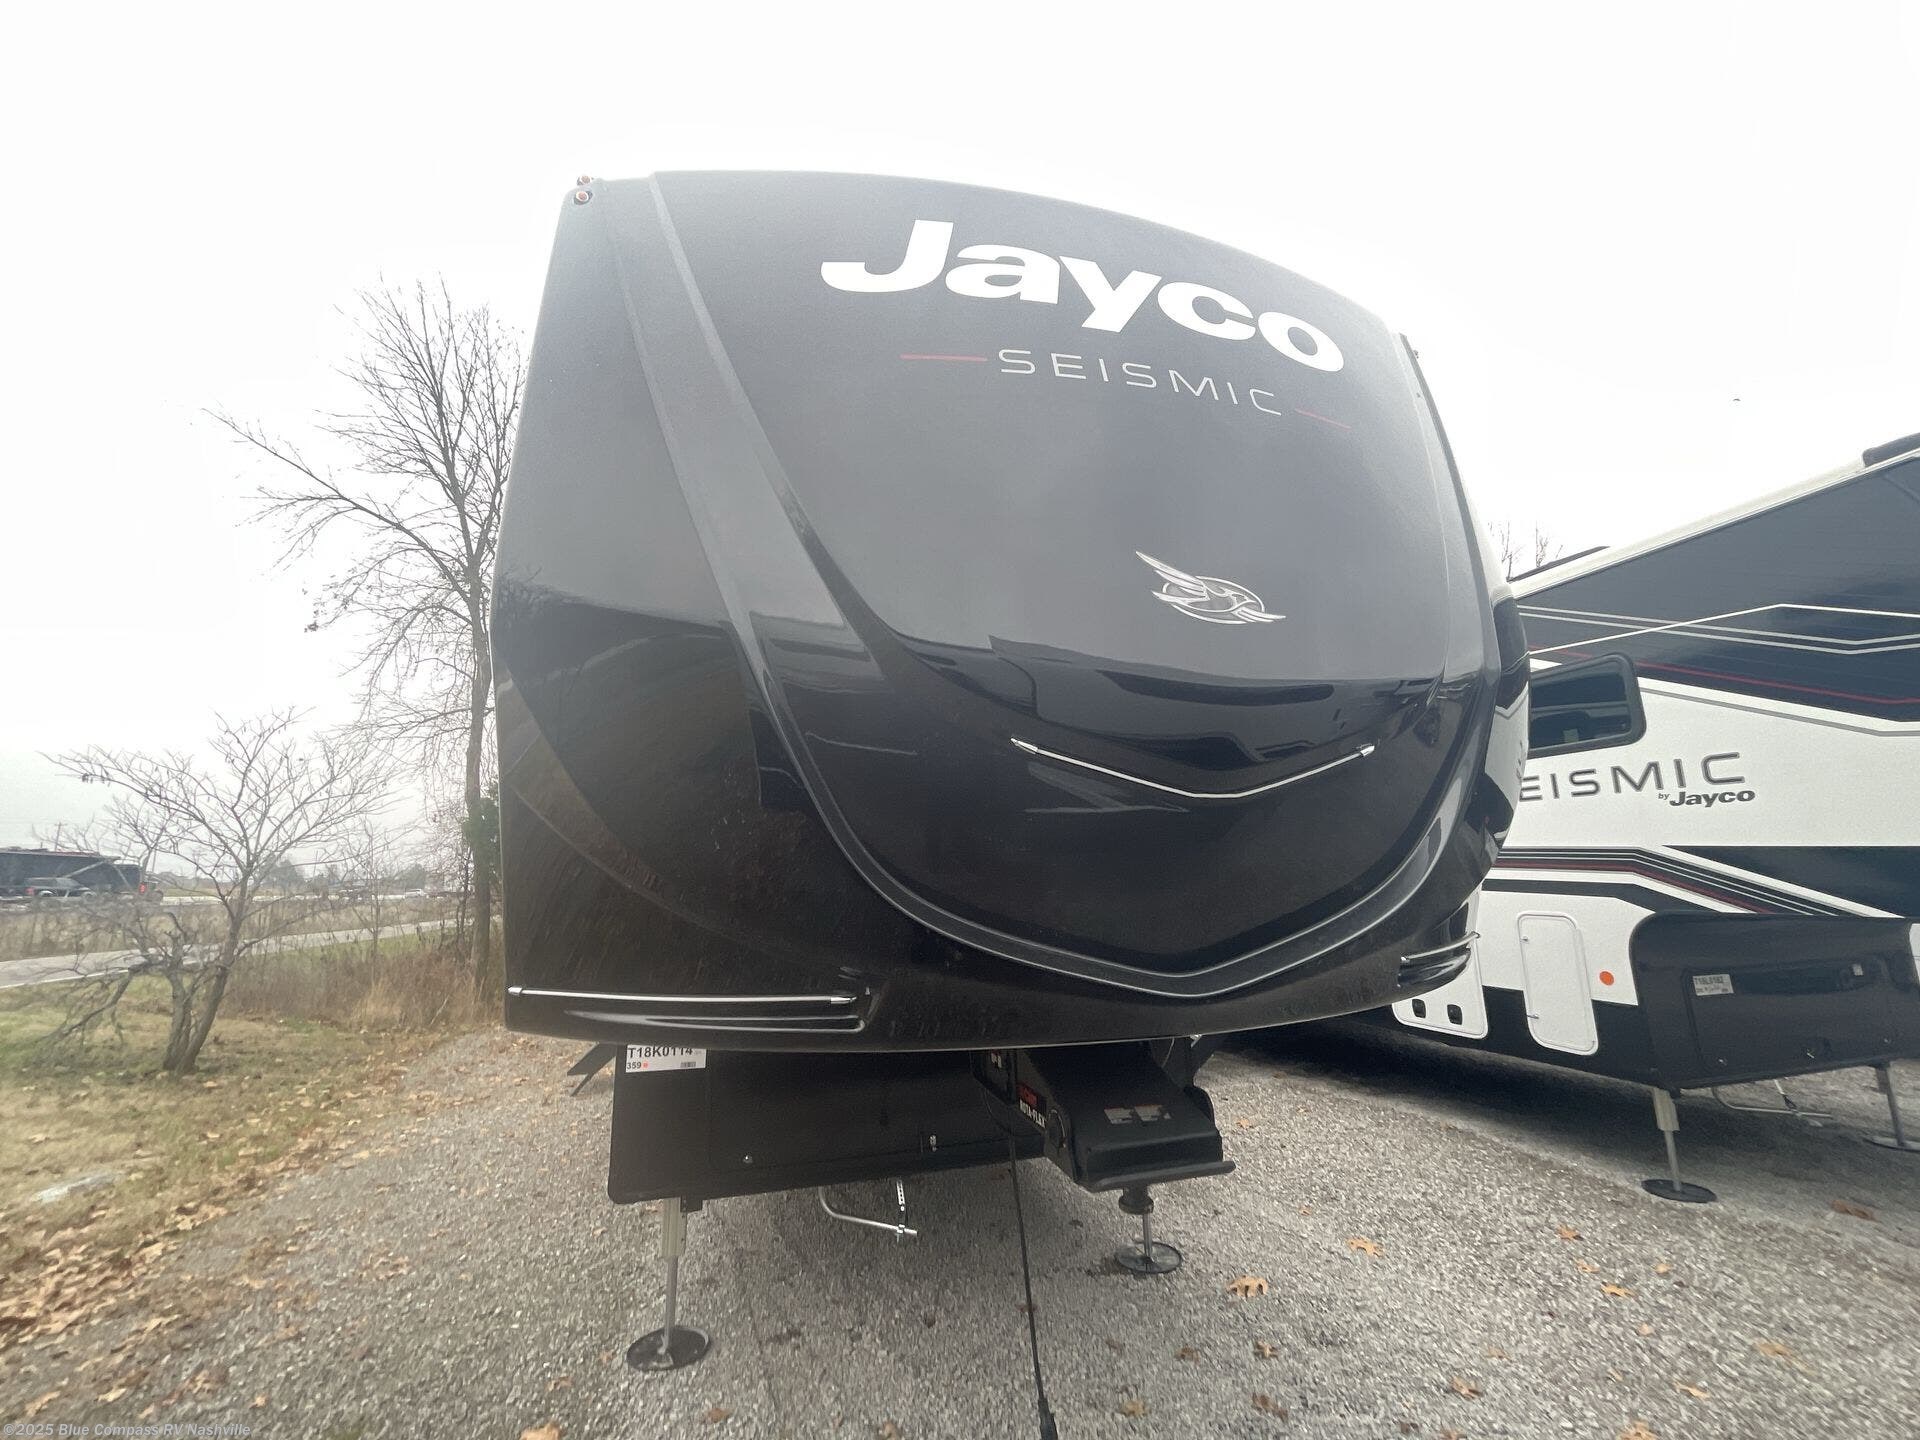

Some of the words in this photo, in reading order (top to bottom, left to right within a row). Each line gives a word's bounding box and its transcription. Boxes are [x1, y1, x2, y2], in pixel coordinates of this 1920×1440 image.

[821, 219, 1344, 372] Jayco
[998, 349, 1282, 416] SEISMIC
[1519, 752, 1746, 801] EISMIC
[1657, 792, 1670, 801] by
[1669, 789, 1756, 807] Jayco
[626, 1061, 642, 1070] 359
